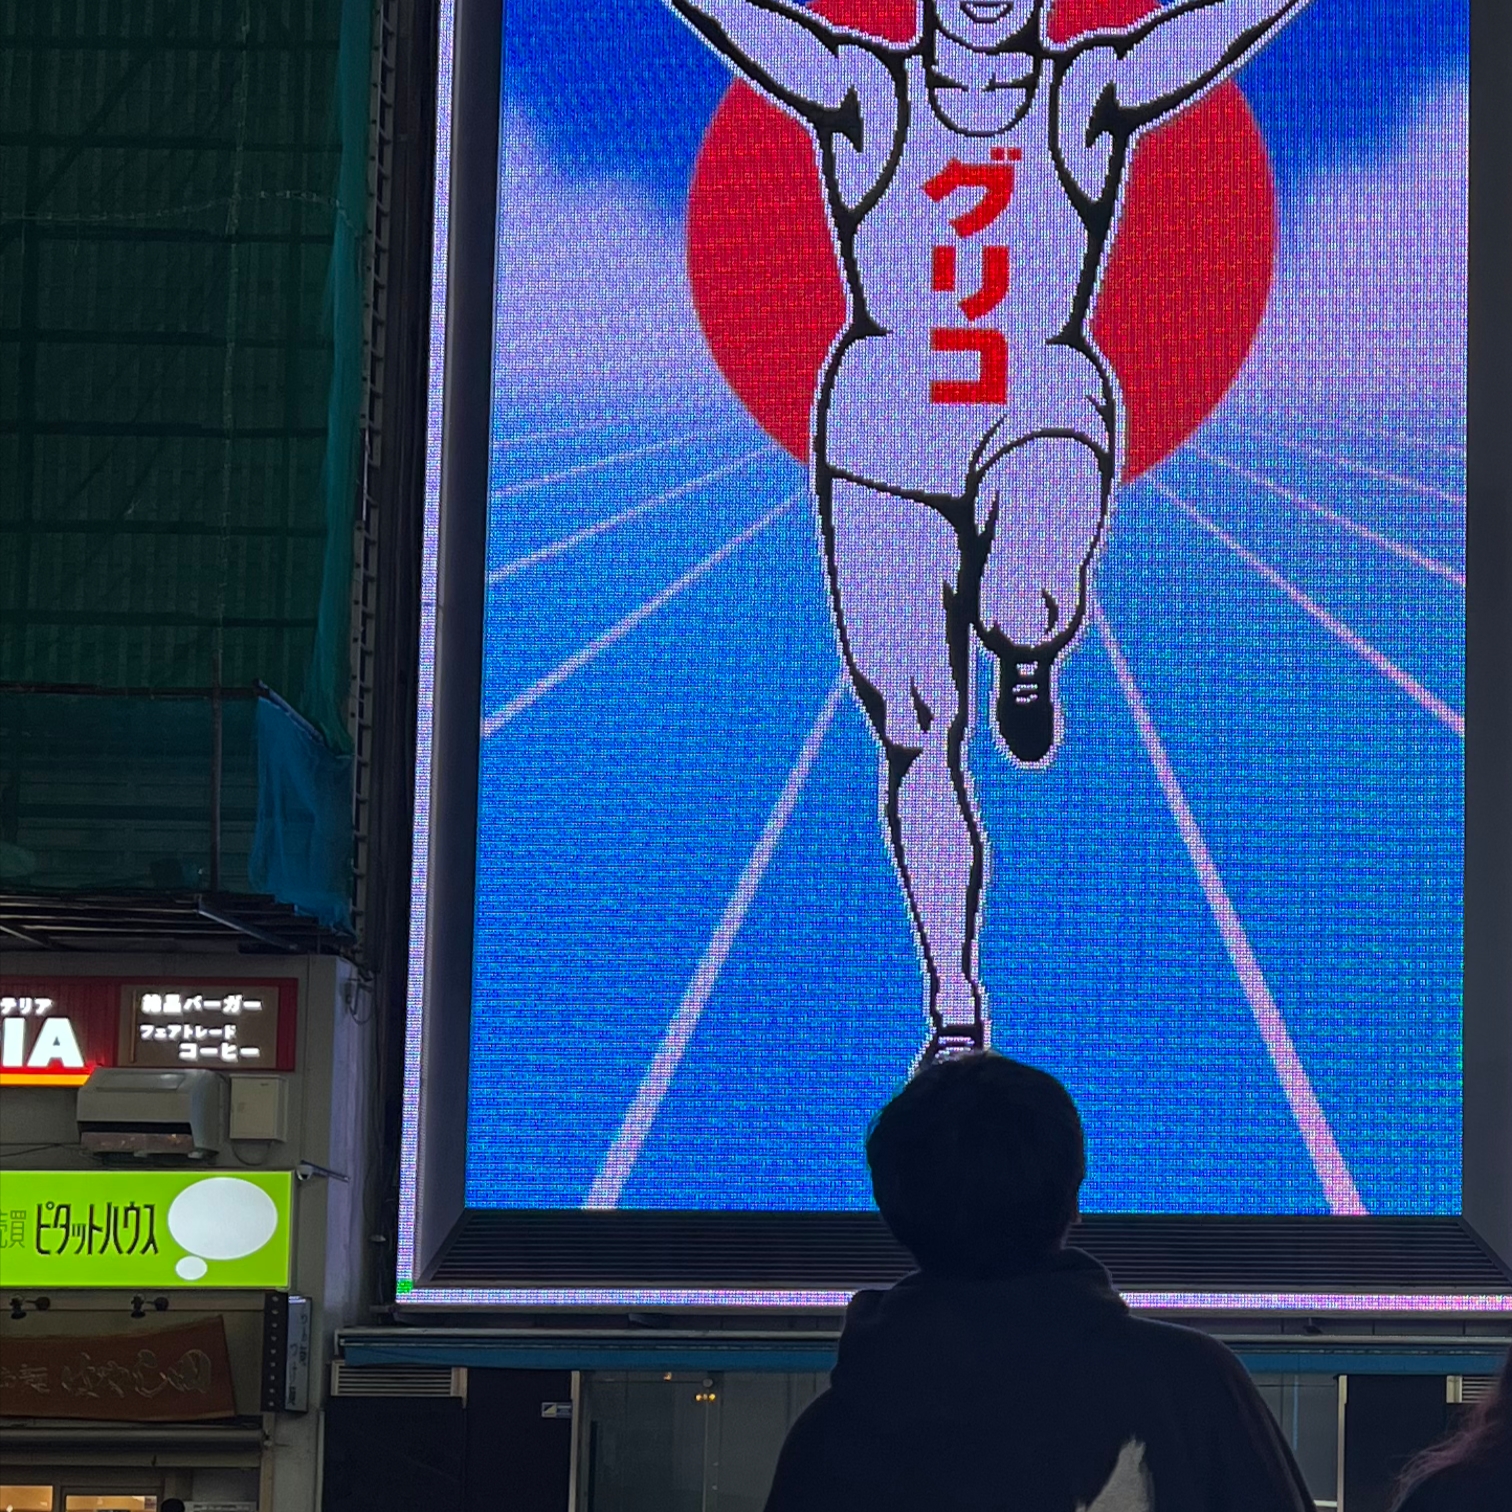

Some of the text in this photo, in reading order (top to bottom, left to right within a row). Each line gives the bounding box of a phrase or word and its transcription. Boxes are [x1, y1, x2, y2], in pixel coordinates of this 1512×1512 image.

[921, 147, 1022, 405] グリコ
[139, 1024, 237, 1041] フェアトレード
[178, 1042, 261, 1063] コーヒー
[35, 1201, 160, 1256] ピタットハウス
